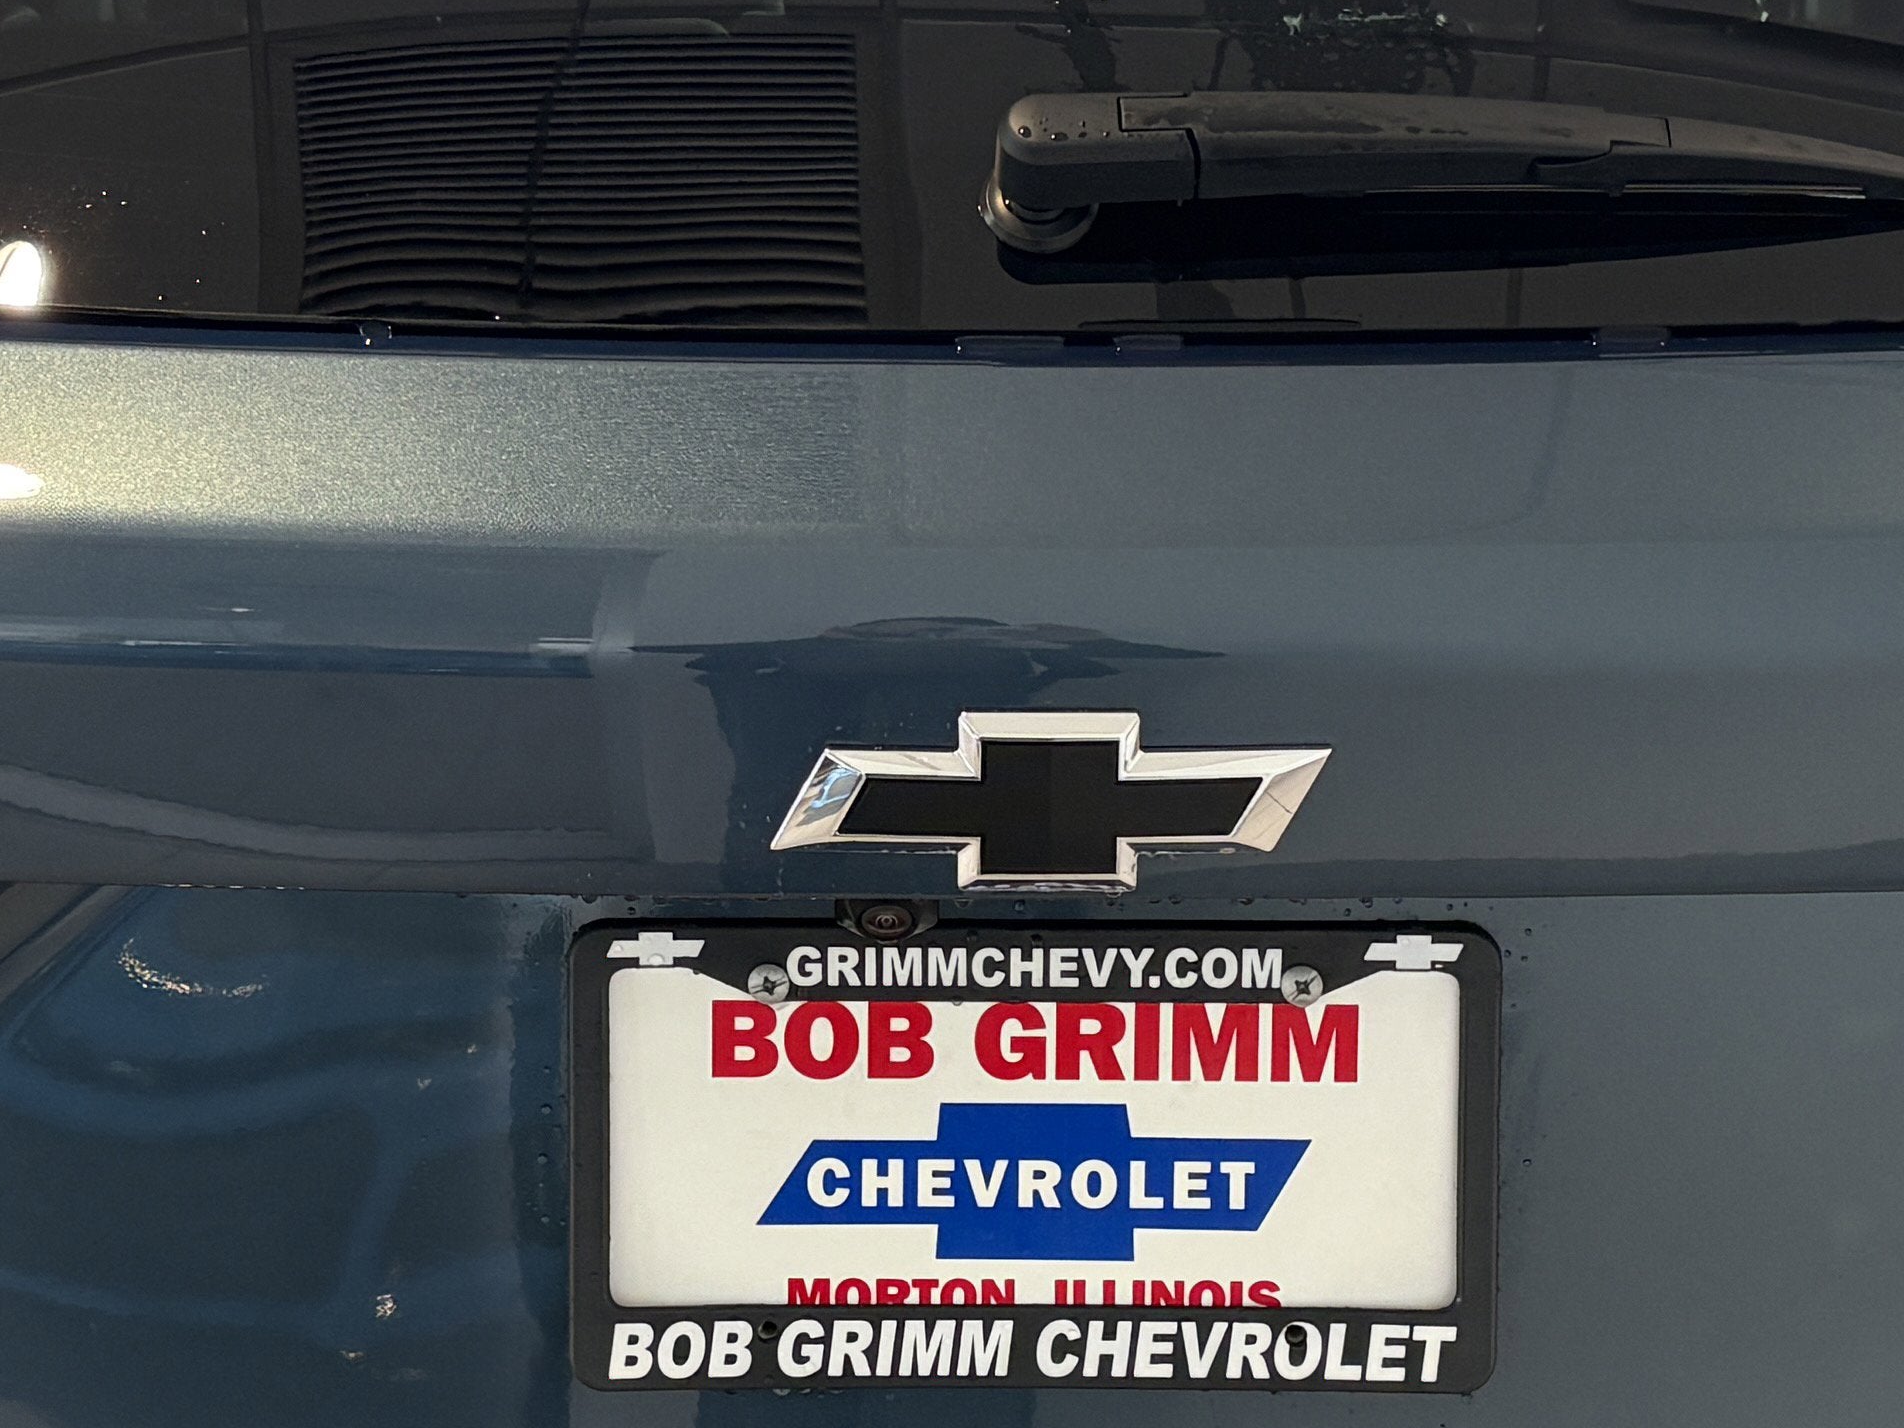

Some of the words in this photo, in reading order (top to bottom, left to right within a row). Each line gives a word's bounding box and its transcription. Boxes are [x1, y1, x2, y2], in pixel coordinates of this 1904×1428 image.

[784, 945, 1284, 990] GRIMMCHEVY.COM
[710, 999, 936, 1081] BOB
[973, 1001, 1361, 1084] GRIMM
[805, 1155, 1257, 1211] CHEVROLET
[607, 1320, 755, 1380] BOB
[776, 1318, 1015, 1378] GRIMM
[1035, 1318, 1459, 1384] CHEVROLET
